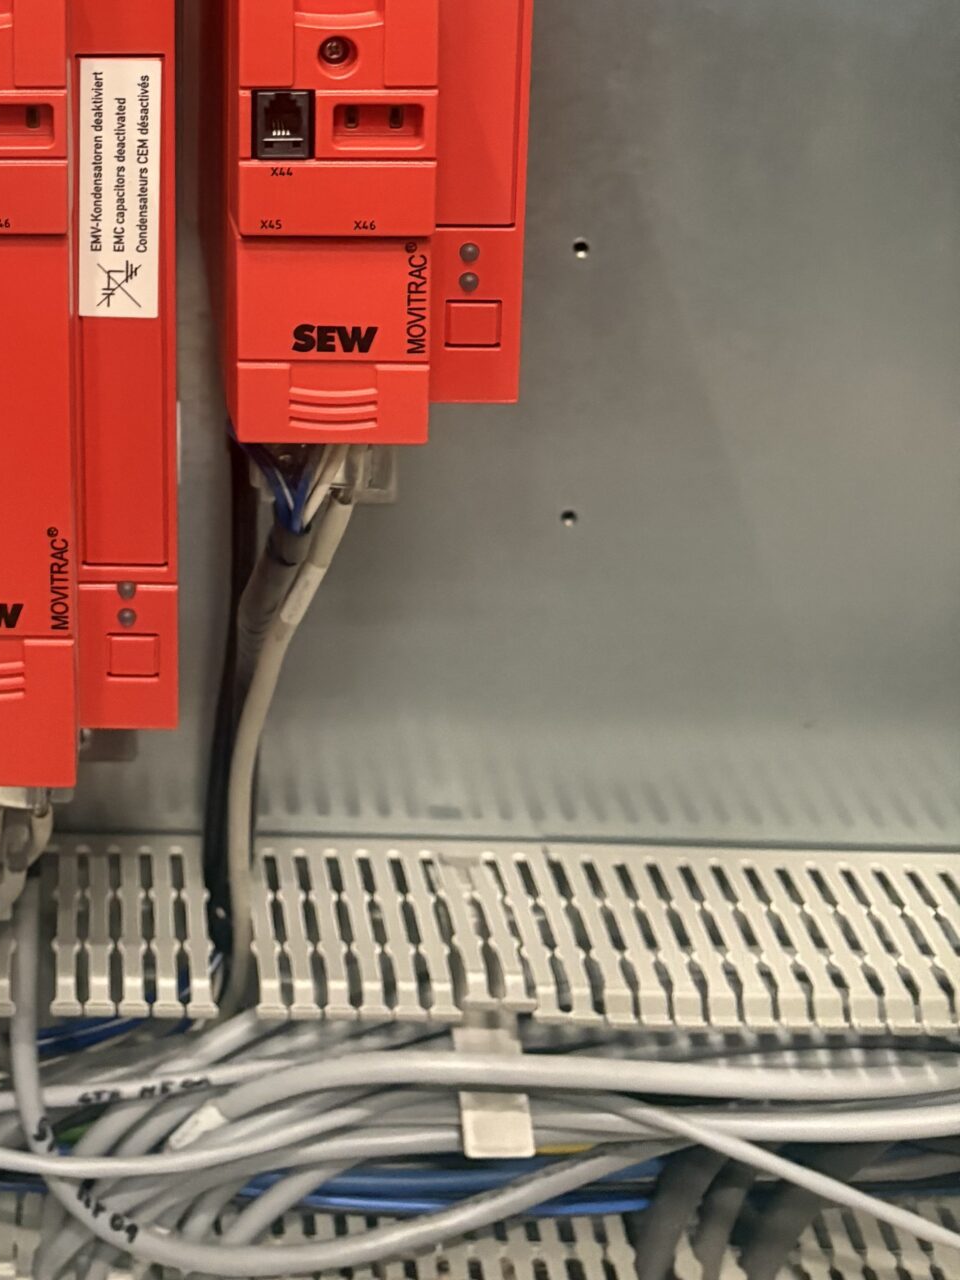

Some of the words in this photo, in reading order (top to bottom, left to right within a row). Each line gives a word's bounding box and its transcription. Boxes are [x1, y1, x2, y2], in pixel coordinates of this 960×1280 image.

[91, 71, 103, 131] deaktiviert
[137, 74, 150, 135] désactivés
[114, 97, 126, 162] deactivated
[137, 139, 149, 164] CEM
[90, 135, 103, 252] EMV-Kondensatoren
[271, 167, 293, 177] X44
[113, 166, 127, 224] capacitors
[136, 168, 148, 253] Condensateurs
[113, 228, 125, 252] EMC
[260, 220, 282, 230] X45
[354, 220, 376, 231] X46
[292, 323, 378, 353] SEW
